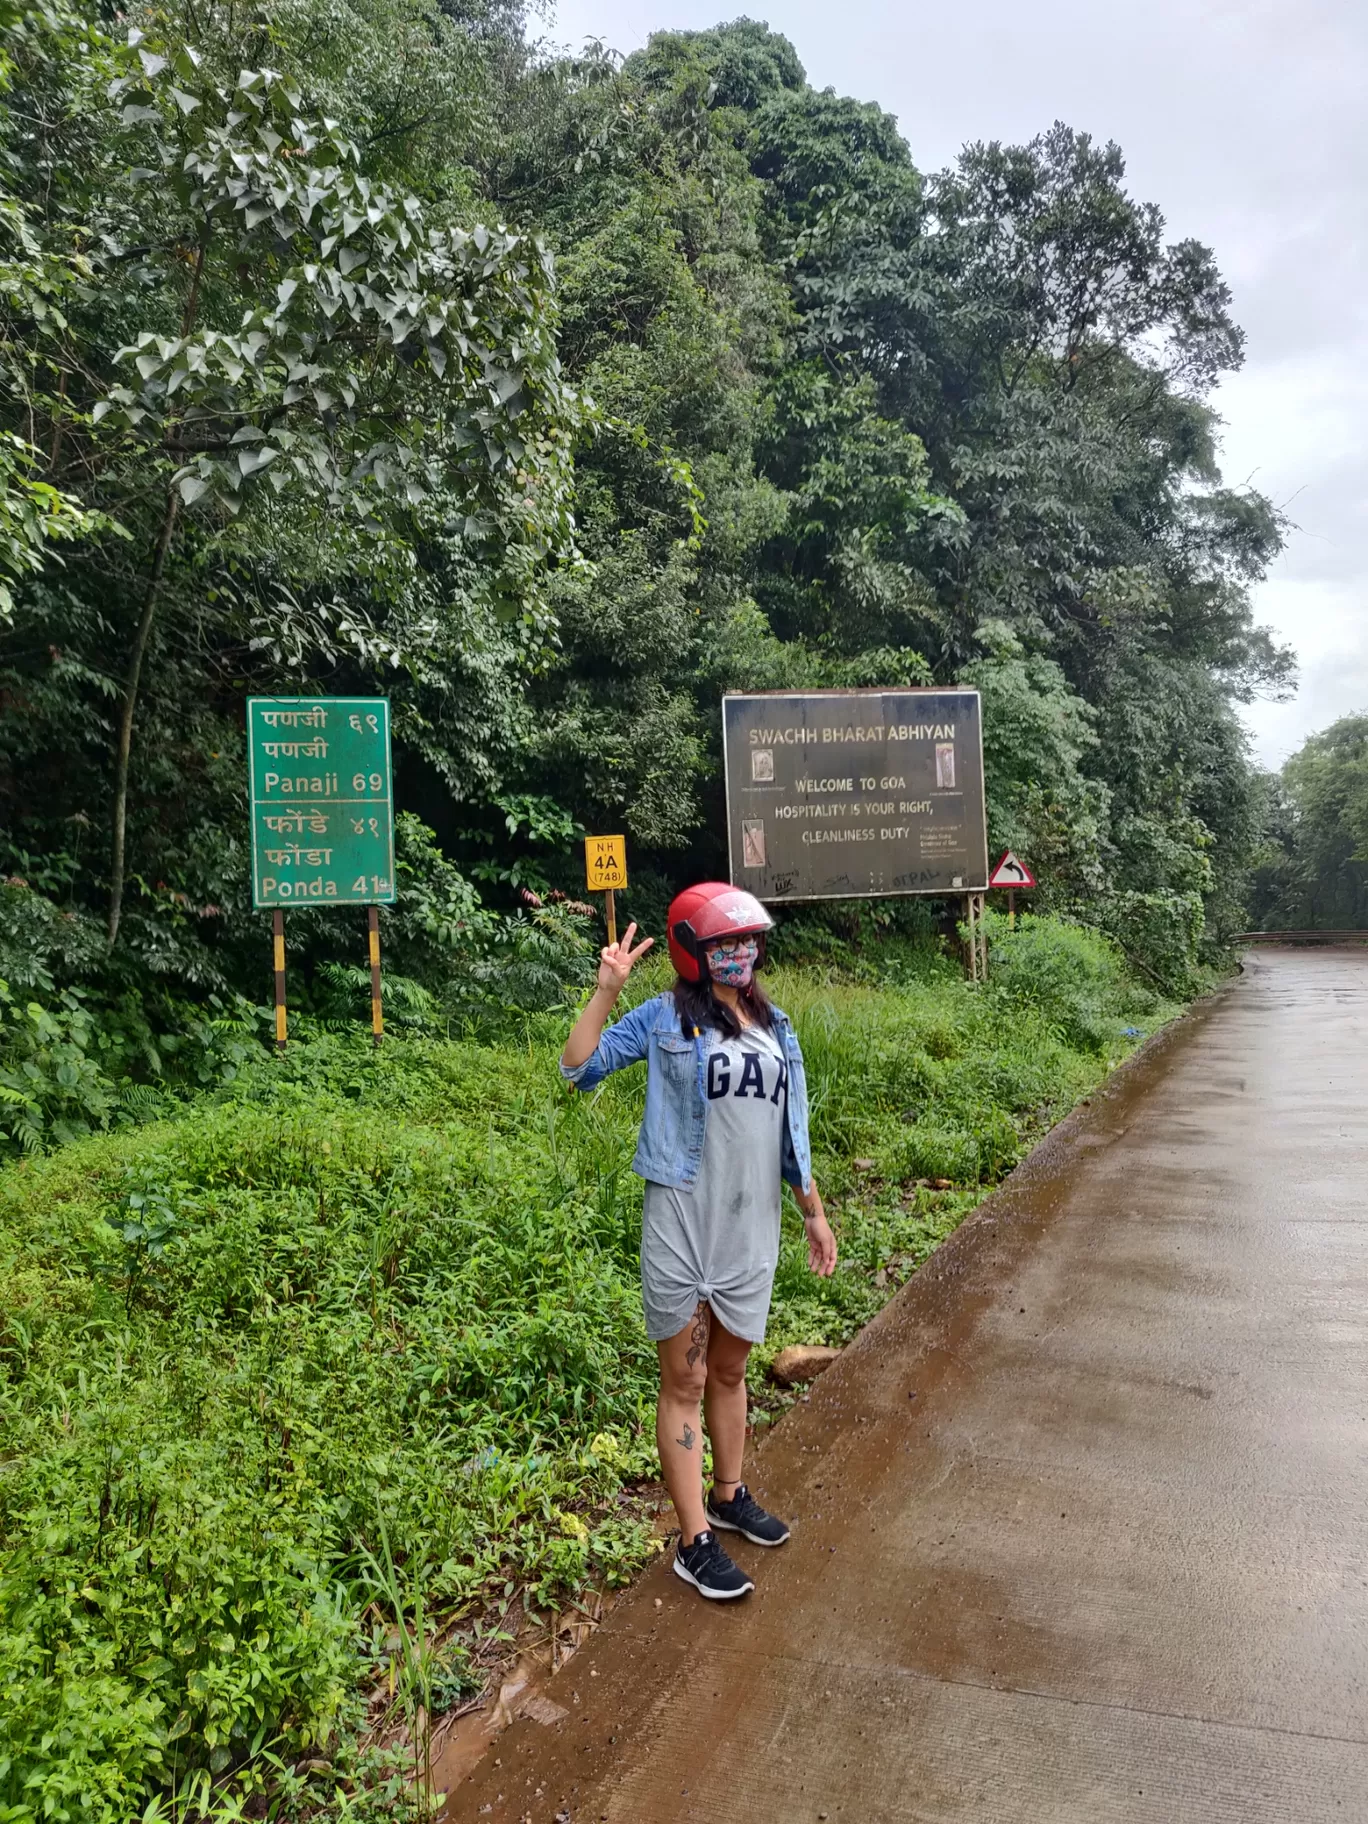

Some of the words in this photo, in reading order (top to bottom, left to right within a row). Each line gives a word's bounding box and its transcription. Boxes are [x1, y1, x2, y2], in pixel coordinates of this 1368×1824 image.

[260, 706, 328, 728] पणजी
[749, 728, 818, 745] SWACHH
[822, 725, 885, 743] BHARAT
[887, 724, 955, 740] ABHIYAN
[261, 736, 329, 759] पणजी
[265, 772, 338, 796] Panaji
[352, 773, 383, 792] 69
[795, 778, 853, 793] WELCOME
[859, 777, 876, 791] TO
[880, 776, 906, 790] GOA
[775, 803, 846, 819] HOSPITALITY
[851, 802, 860, 816] IS
[864, 801, 895, 815] YOUR
[899, 801, 934, 815] RIGHT,
[350, 817, 379, 839] ४१
[802, 828, 876, 844] CLEANLINESS
[880, 827, 910, 840] DUTY
[594, 855, 618, 869] 4A
[262, 876, 338, 898] Ponda
[352, 875, 379, 895] 41
[594, 871, 621, 882] (748)
